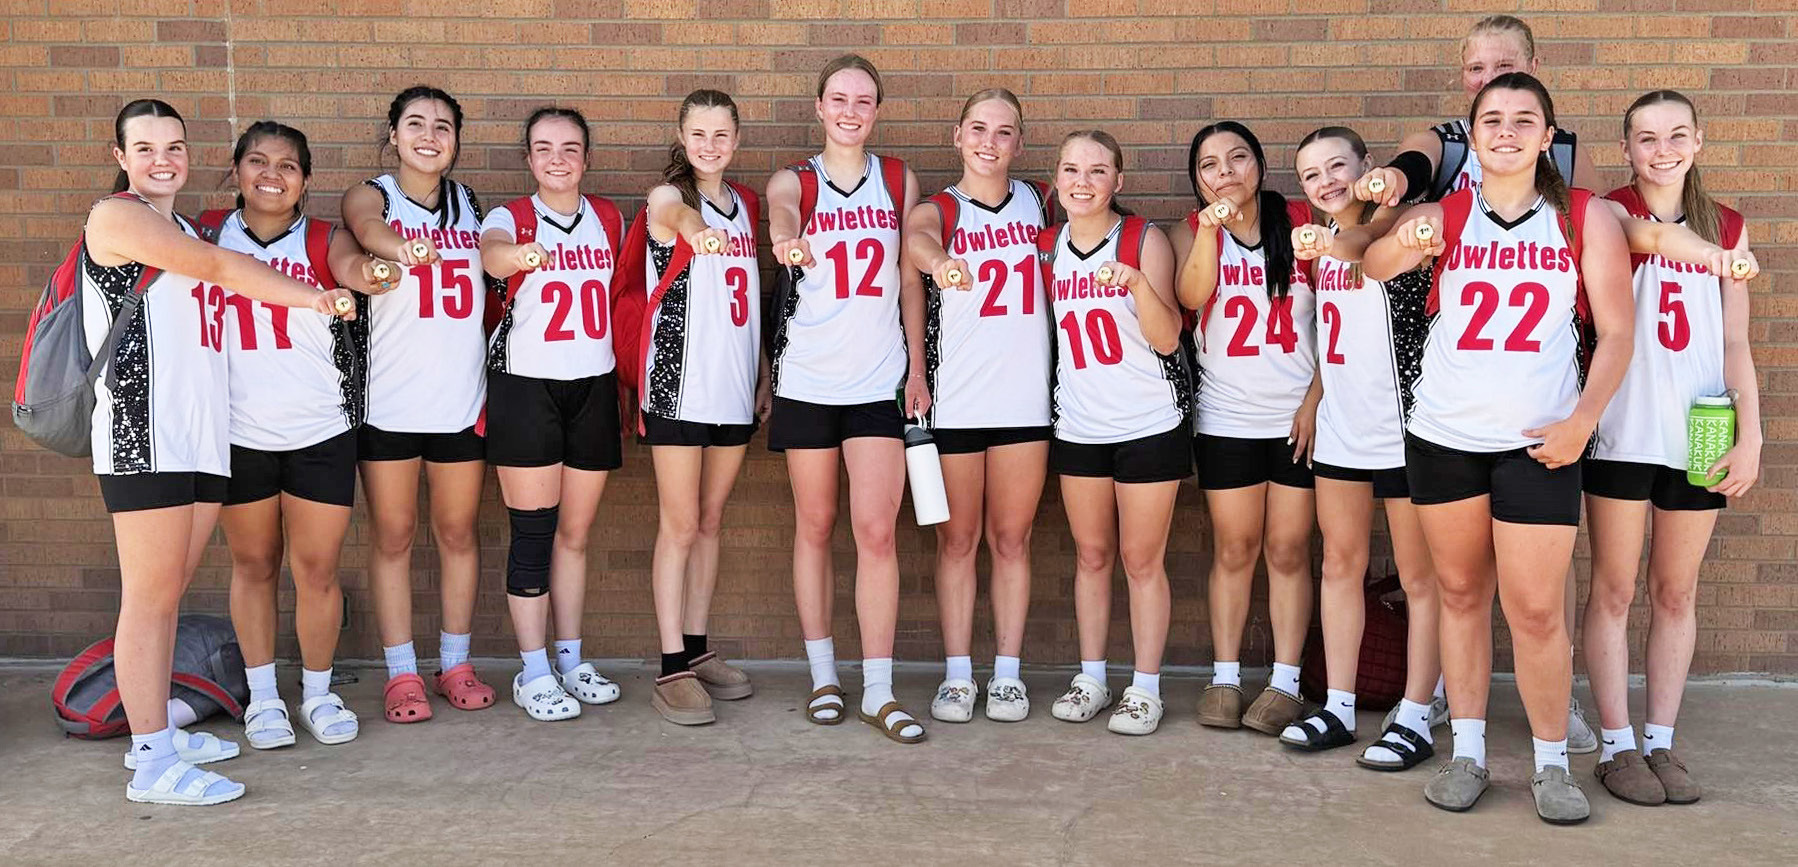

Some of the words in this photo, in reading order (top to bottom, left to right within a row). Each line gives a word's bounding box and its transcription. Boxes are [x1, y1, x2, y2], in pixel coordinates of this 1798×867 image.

[528, 242, 612, 274] wlettes
[825, 238, 885, 299] 12
[954, 220, 1040, 255] Owlette
[191, 281, 226, 353] 13
[409, 259, 474, 320] 15
[540, 279, 608, 343] 20
[724, 266, 749, 328] 3
[978, 254, 1035, 318] 21
[1457, 281, 1550, 353] 22
[1657, 281, 1691, 352] 5
[1060, 308, 1123, 370] 10
[1224, 295, 1298, 357] 24
[1322, 301, 1346, 365] 2
[1693, 418, 1703, 471] KANAKUK
